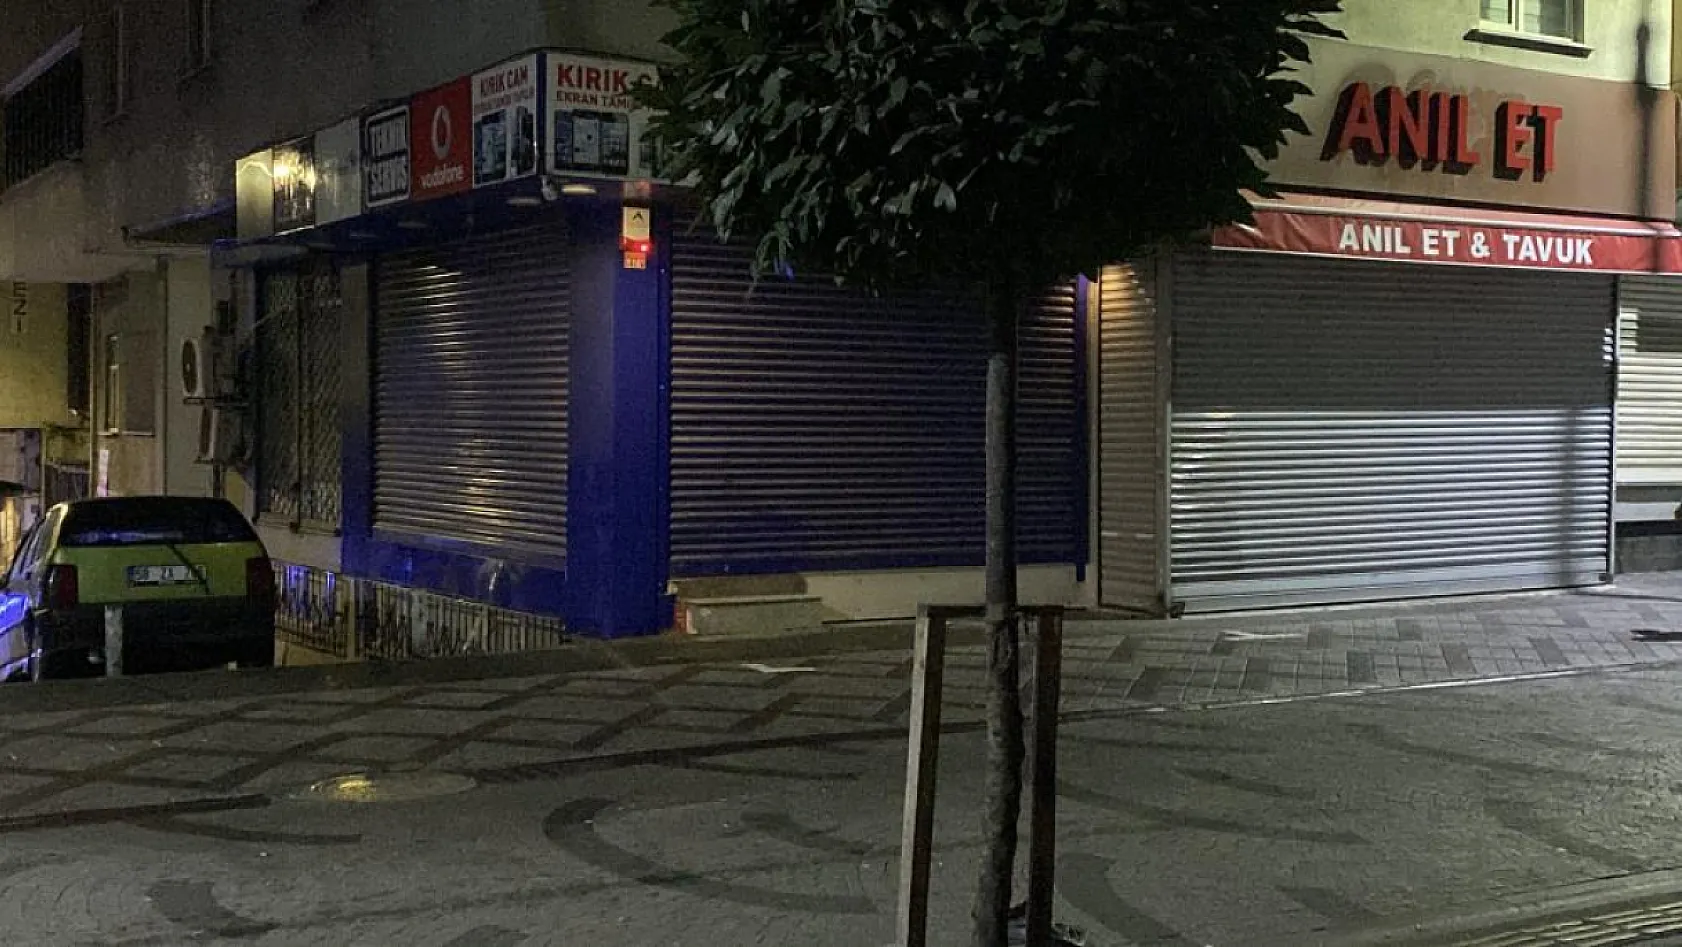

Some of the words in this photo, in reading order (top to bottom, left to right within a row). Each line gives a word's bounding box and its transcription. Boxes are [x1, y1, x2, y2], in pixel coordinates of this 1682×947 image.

[557, 63, 629, 94] KIRIK
[556, 90, 598, 106] EKRAN
[1330, 82, 1482, 172] ANIL
[1500, 100, 1563, 178] ET
[420, 163, 464, 189] vodafone
[1338, 223, 1411, 255] ANIL
[1422, 229, 1462, 257] ET
[1470, 231, 1491, 260] &
[1502, 234, 1594, 265] TAVUK
